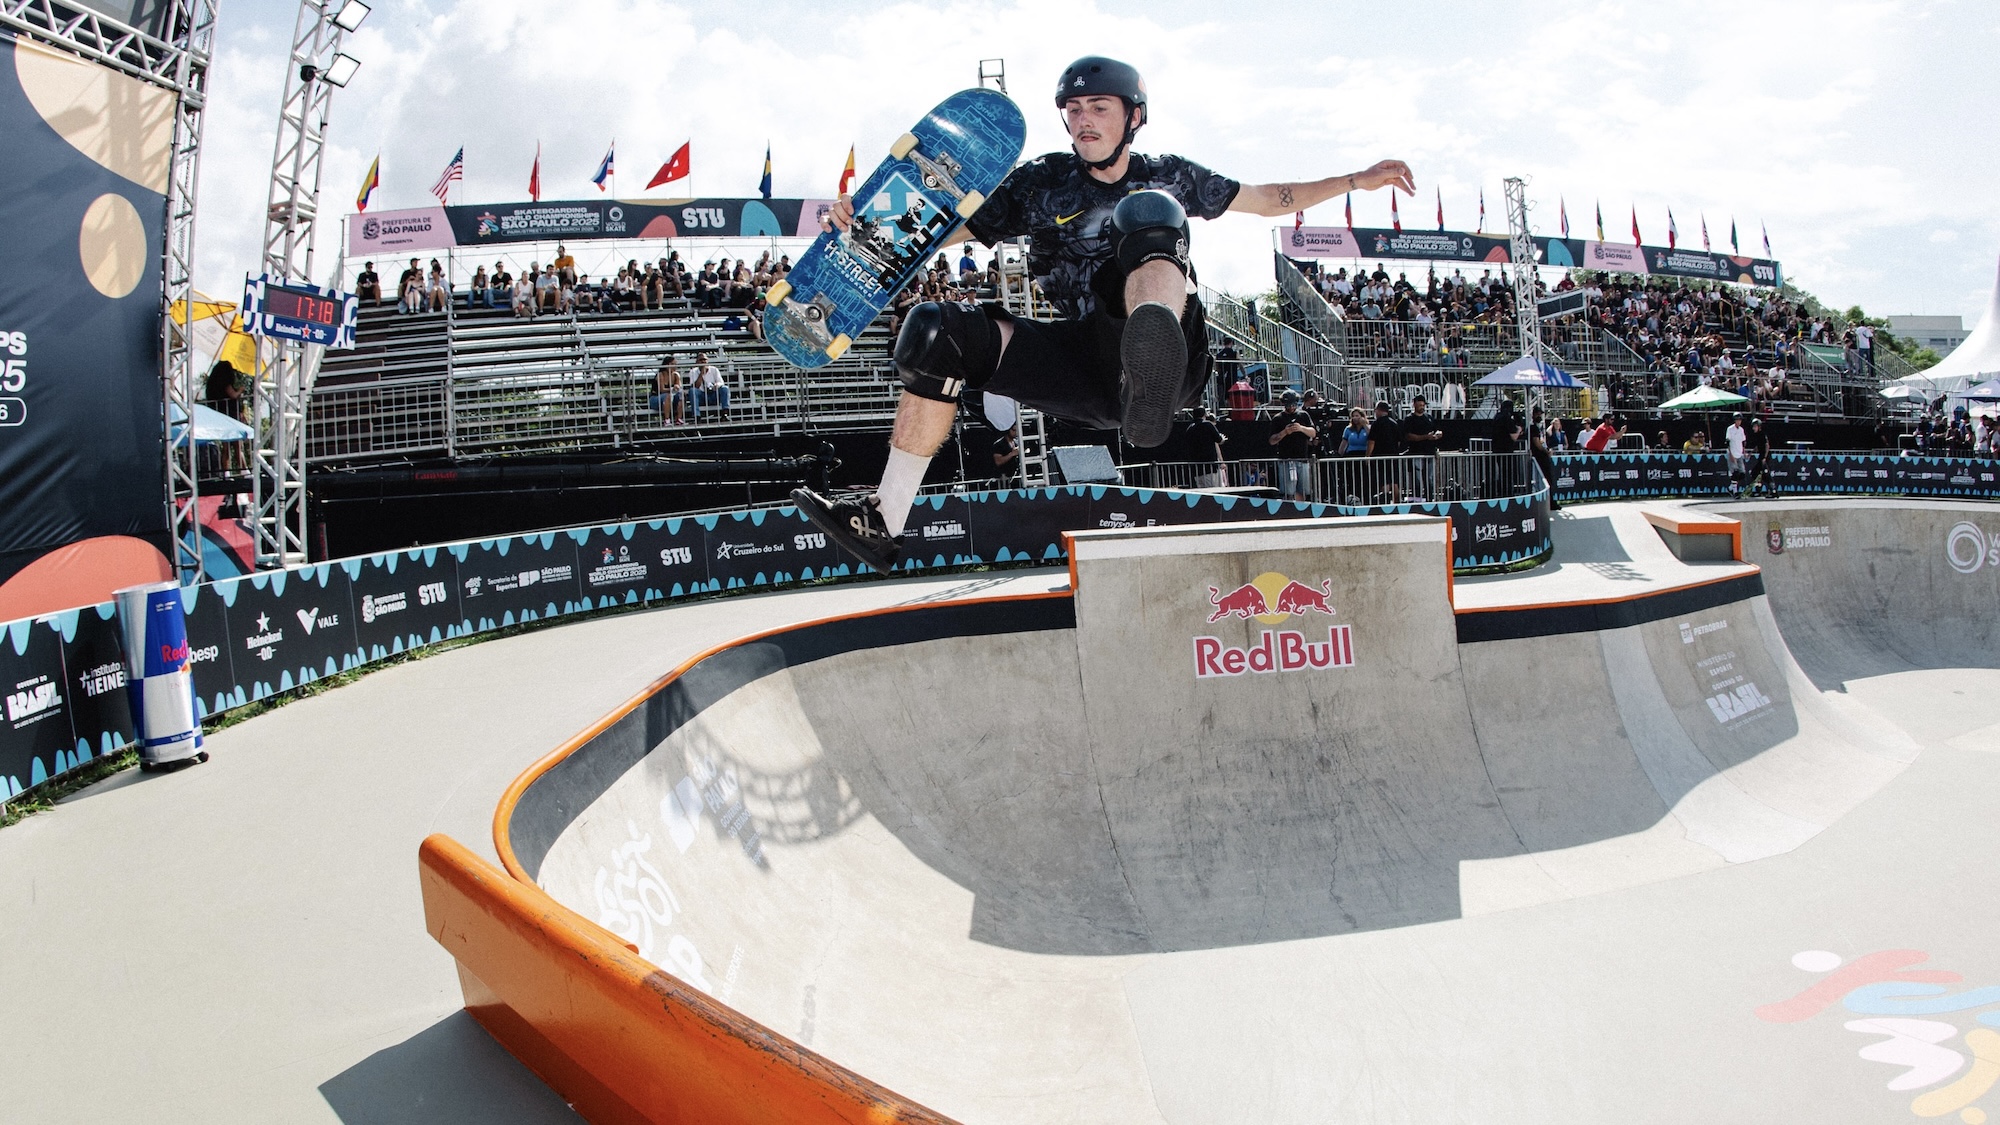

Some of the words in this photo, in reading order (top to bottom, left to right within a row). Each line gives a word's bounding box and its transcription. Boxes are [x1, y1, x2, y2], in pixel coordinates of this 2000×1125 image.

[501, 214, 533, 222] WORLD
[514, 207, 587, 217] SKATEBOARDING
[682, 207, 725, 228] STU
[382, 218, 422, 226] PREFEITURA
[402, 223, 432, 234] PAULO
[529, 218, 570, 228] PAULO
[571, 218, 600, 227] 2025
[1753, 265, 1775, 280] STU
[297, 296, 334, 325] 17:18
[1625, 469, 1639, 480] STU
[1678, 469, 1692, 478] STU
[1873, 470, 1888, 478] STU
[1980, 473, 1994, 482] STU
[923, 523, 966, 538] BRASIL
[1521, 518, 1536, 533] STU
[1785, 526, 1821, 536] PREFEITURA
[1821, 526, 1830, 534] DE
[793, 533, 827, 550] STU
[1786, 536, 1804, 549] SÃO
[1804, 536, 1831, 548] PAULO
[660, 547, 692, 566] STU
[733, 546, 763, 556] Cruzeiro
[763, 545, 773, 553] do
[773, 543, 785, 552] Sul
[553, 565, 572, 574] PAULO
[605, 571, 630, 581] PAULO
[519, 569, 541, 588] SP
[418, 581, 447, 606] STU
[387, 600, 407, 613] PAULO
[317, 614, 339, 629] VALE
[1693, 620, 1728, 636] PETROBRAS
[246, 629, 283, 649] Heineken
[189, 646, 218, 664] besp
[1194, 630, 1276, 678] Red
[1277, 625, 1354, 672] Bull
[90, 662, 121, 677] instituto
[1709, 663, 1734, 676] ESPORTE
[87, 671, 124, 697] HEINE
[6, 681, 63, 722] BRASIL
[1705, 682, 1771, 723] BRASIL
[734, 809, 752, 831] ESTADO
[725, 943, 745, 984] ESPORTE
